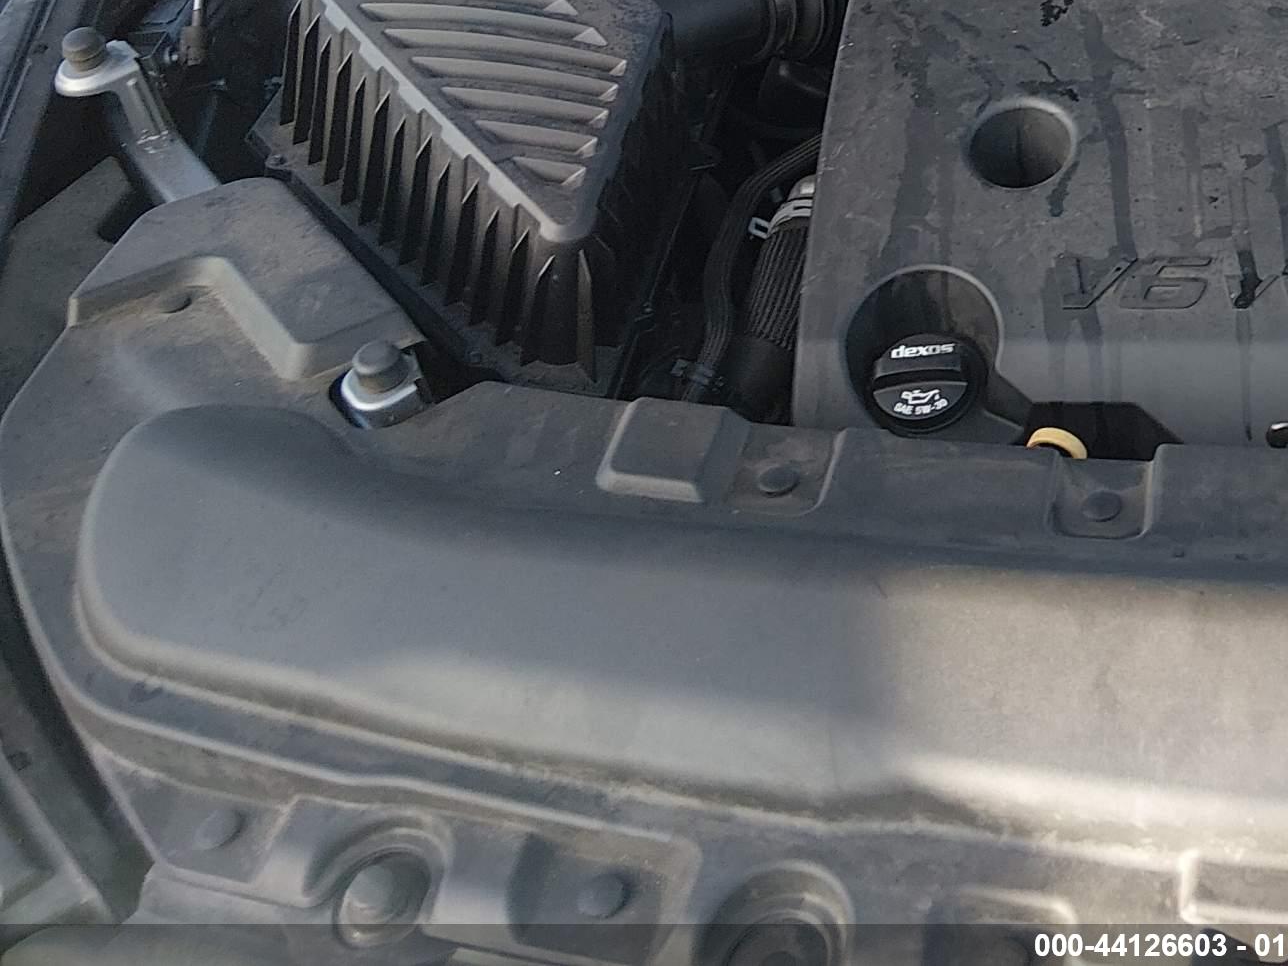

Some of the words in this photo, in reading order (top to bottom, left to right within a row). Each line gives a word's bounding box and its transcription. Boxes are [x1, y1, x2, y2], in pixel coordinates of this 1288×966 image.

[1055, 255, 1213, 310] V6
[890, 343, 956, 359] dexos
[893, 401, 915, 415] SAE
